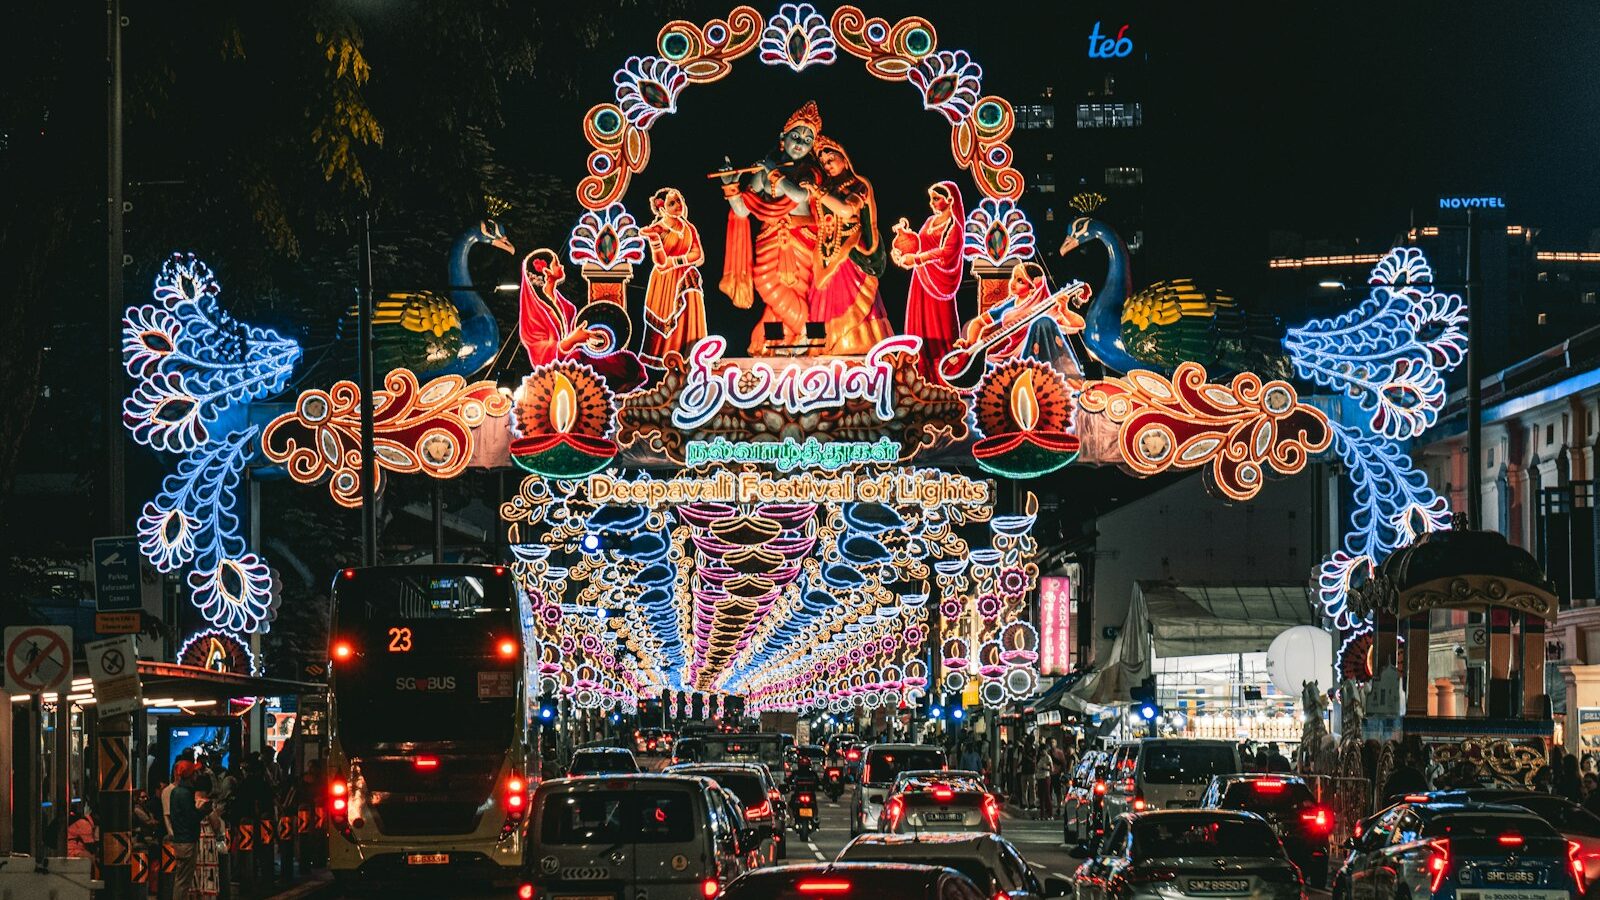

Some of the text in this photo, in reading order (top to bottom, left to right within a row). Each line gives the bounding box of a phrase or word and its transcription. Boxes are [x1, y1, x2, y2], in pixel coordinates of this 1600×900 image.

[1439, 197, 1505, 209] NOVOTEL
[672, 334, 923, 430] தீபாவளி
[589, 472, 989, 506] Deepavali Festival of Lights
[388, 627, 412, 652] 23
